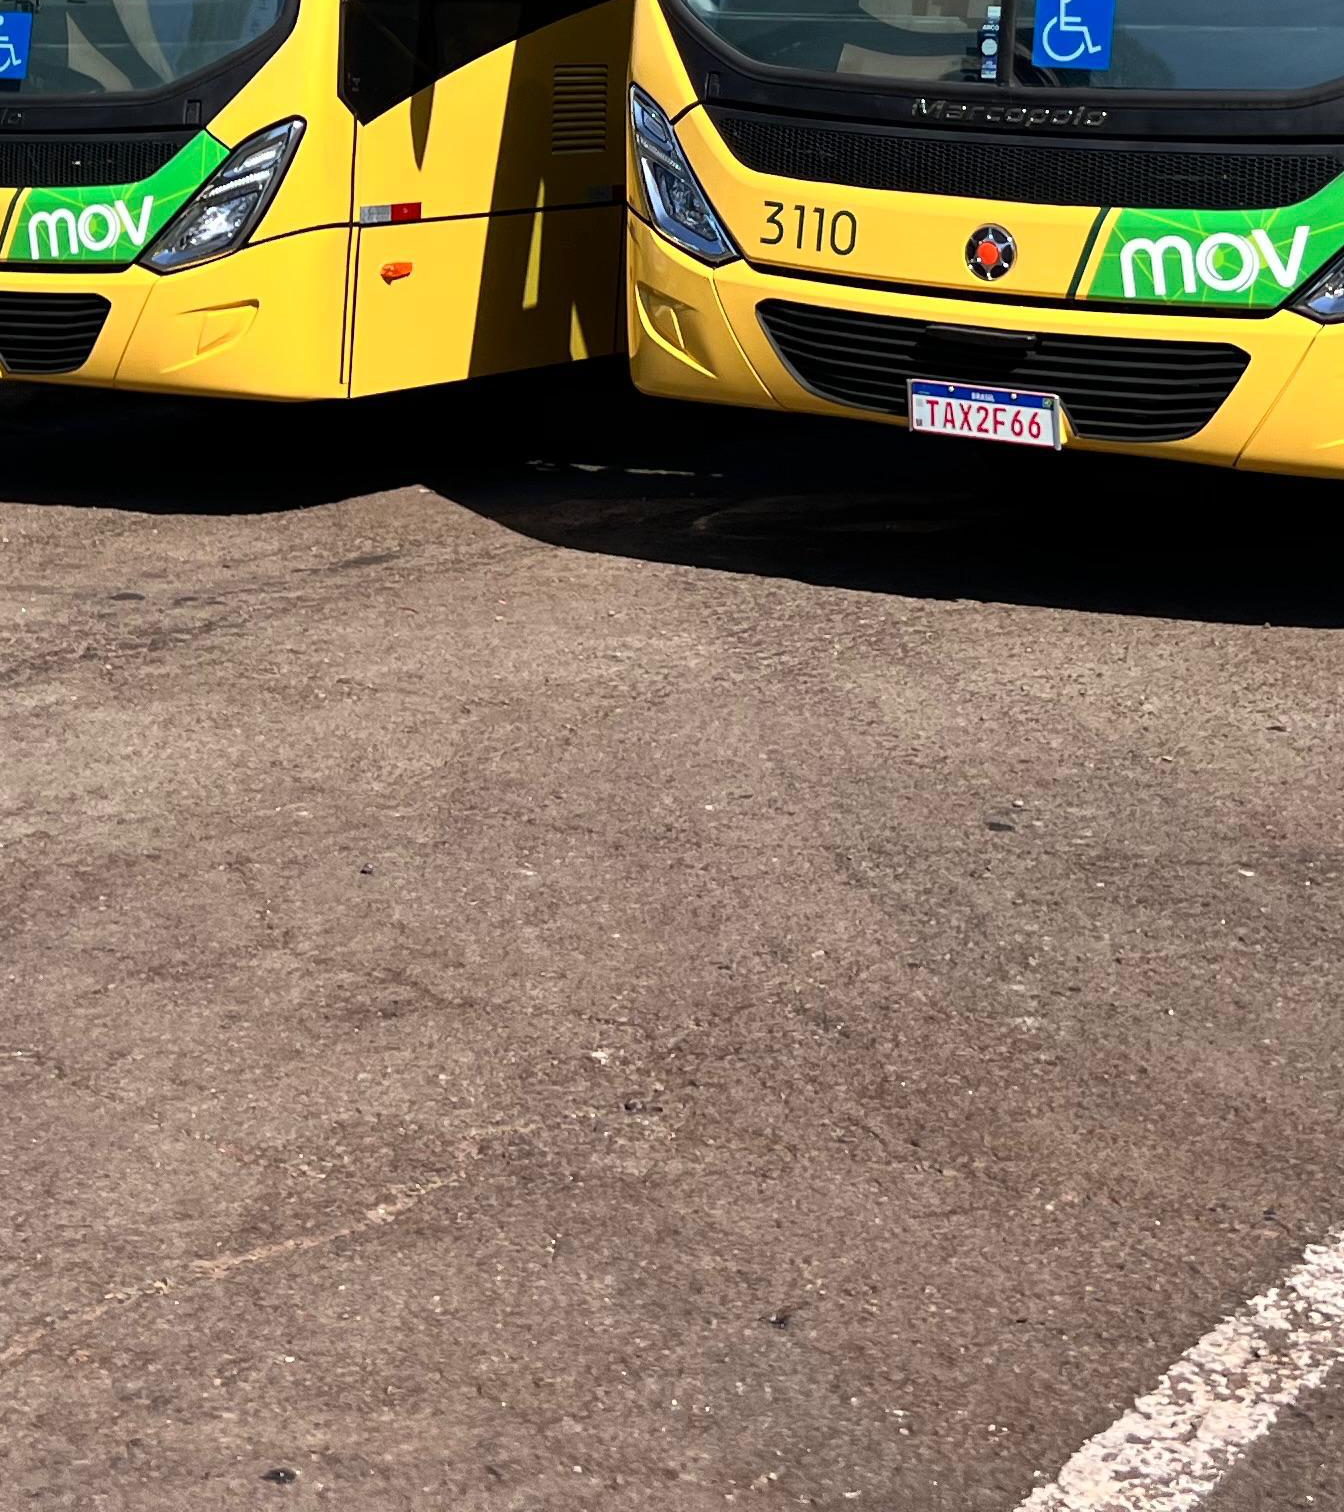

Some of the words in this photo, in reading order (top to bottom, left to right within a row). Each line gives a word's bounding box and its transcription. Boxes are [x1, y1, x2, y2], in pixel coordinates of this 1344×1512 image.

[912, 98, 1107, 128] Marcopolo
[759, 200, 857, 256] 3110
[926, 399, 1042, 440] TAX2F66
